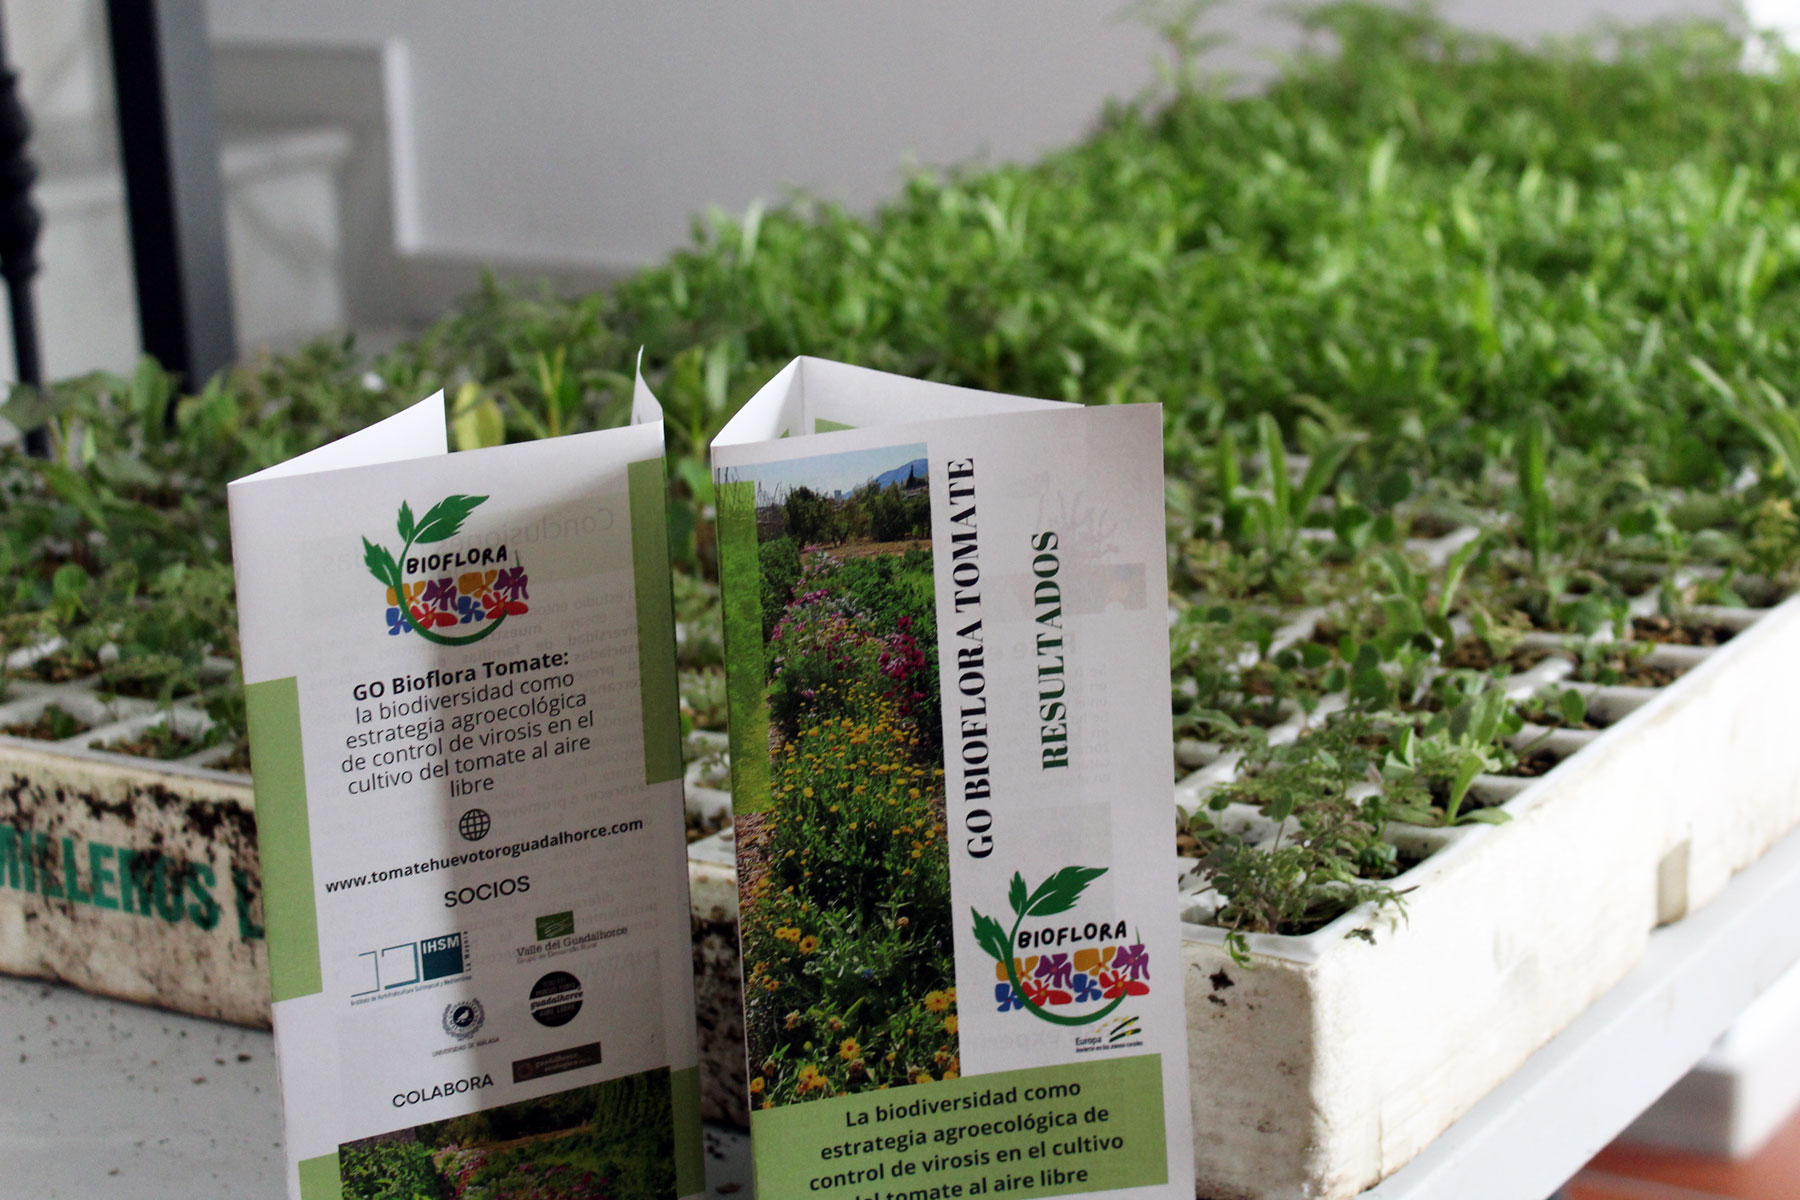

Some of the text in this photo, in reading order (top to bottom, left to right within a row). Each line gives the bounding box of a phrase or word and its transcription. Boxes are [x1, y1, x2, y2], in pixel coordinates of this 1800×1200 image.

[406, 545, 508, 574] BIOFLORA
[947, 457, 994, 859] GO BIOFLORA TOMATE
[1031, 530, 1069, 771] RESULTADOS
[353, 651, 569, 701] GO Bioflora Tomate:
[355, 672, 574, 725] la biodiversidad como
[341, 710, 594, 773] de control de virosis en el
[346, 691, 587, 749] estrategia agroecológica
[348, 735, 591, 795] cultivo del tomate al aire
[450, 777, 494, 798] libre
[325, 817, 644, 893] www.tomatehuevotoroguadalhorce.com
[444, 875, 531, 908] SOCIOS
[422, 935, 460, 954] IHSM
[516, 944, 542, 957] Valle
[545, 940, 560, 951] del
[563, 926, 628, 947] Guadalhorce
[1018, 920, 1127, 949] BIOFLORA
[392, 1073, 494, 1108] COLABORA
[845, 1081, 1081, 1128] La biodiversidad como
[820, 1105, 1109, 1161] estrategia agroecológica de
[809, 1132, 1124, 1191] control de virosis en el cultivo
[969, 1176, 987, 1195] al
[994, 1171, 1035, 1193] aire
[1041, 1166, 1089, 1186] libre
